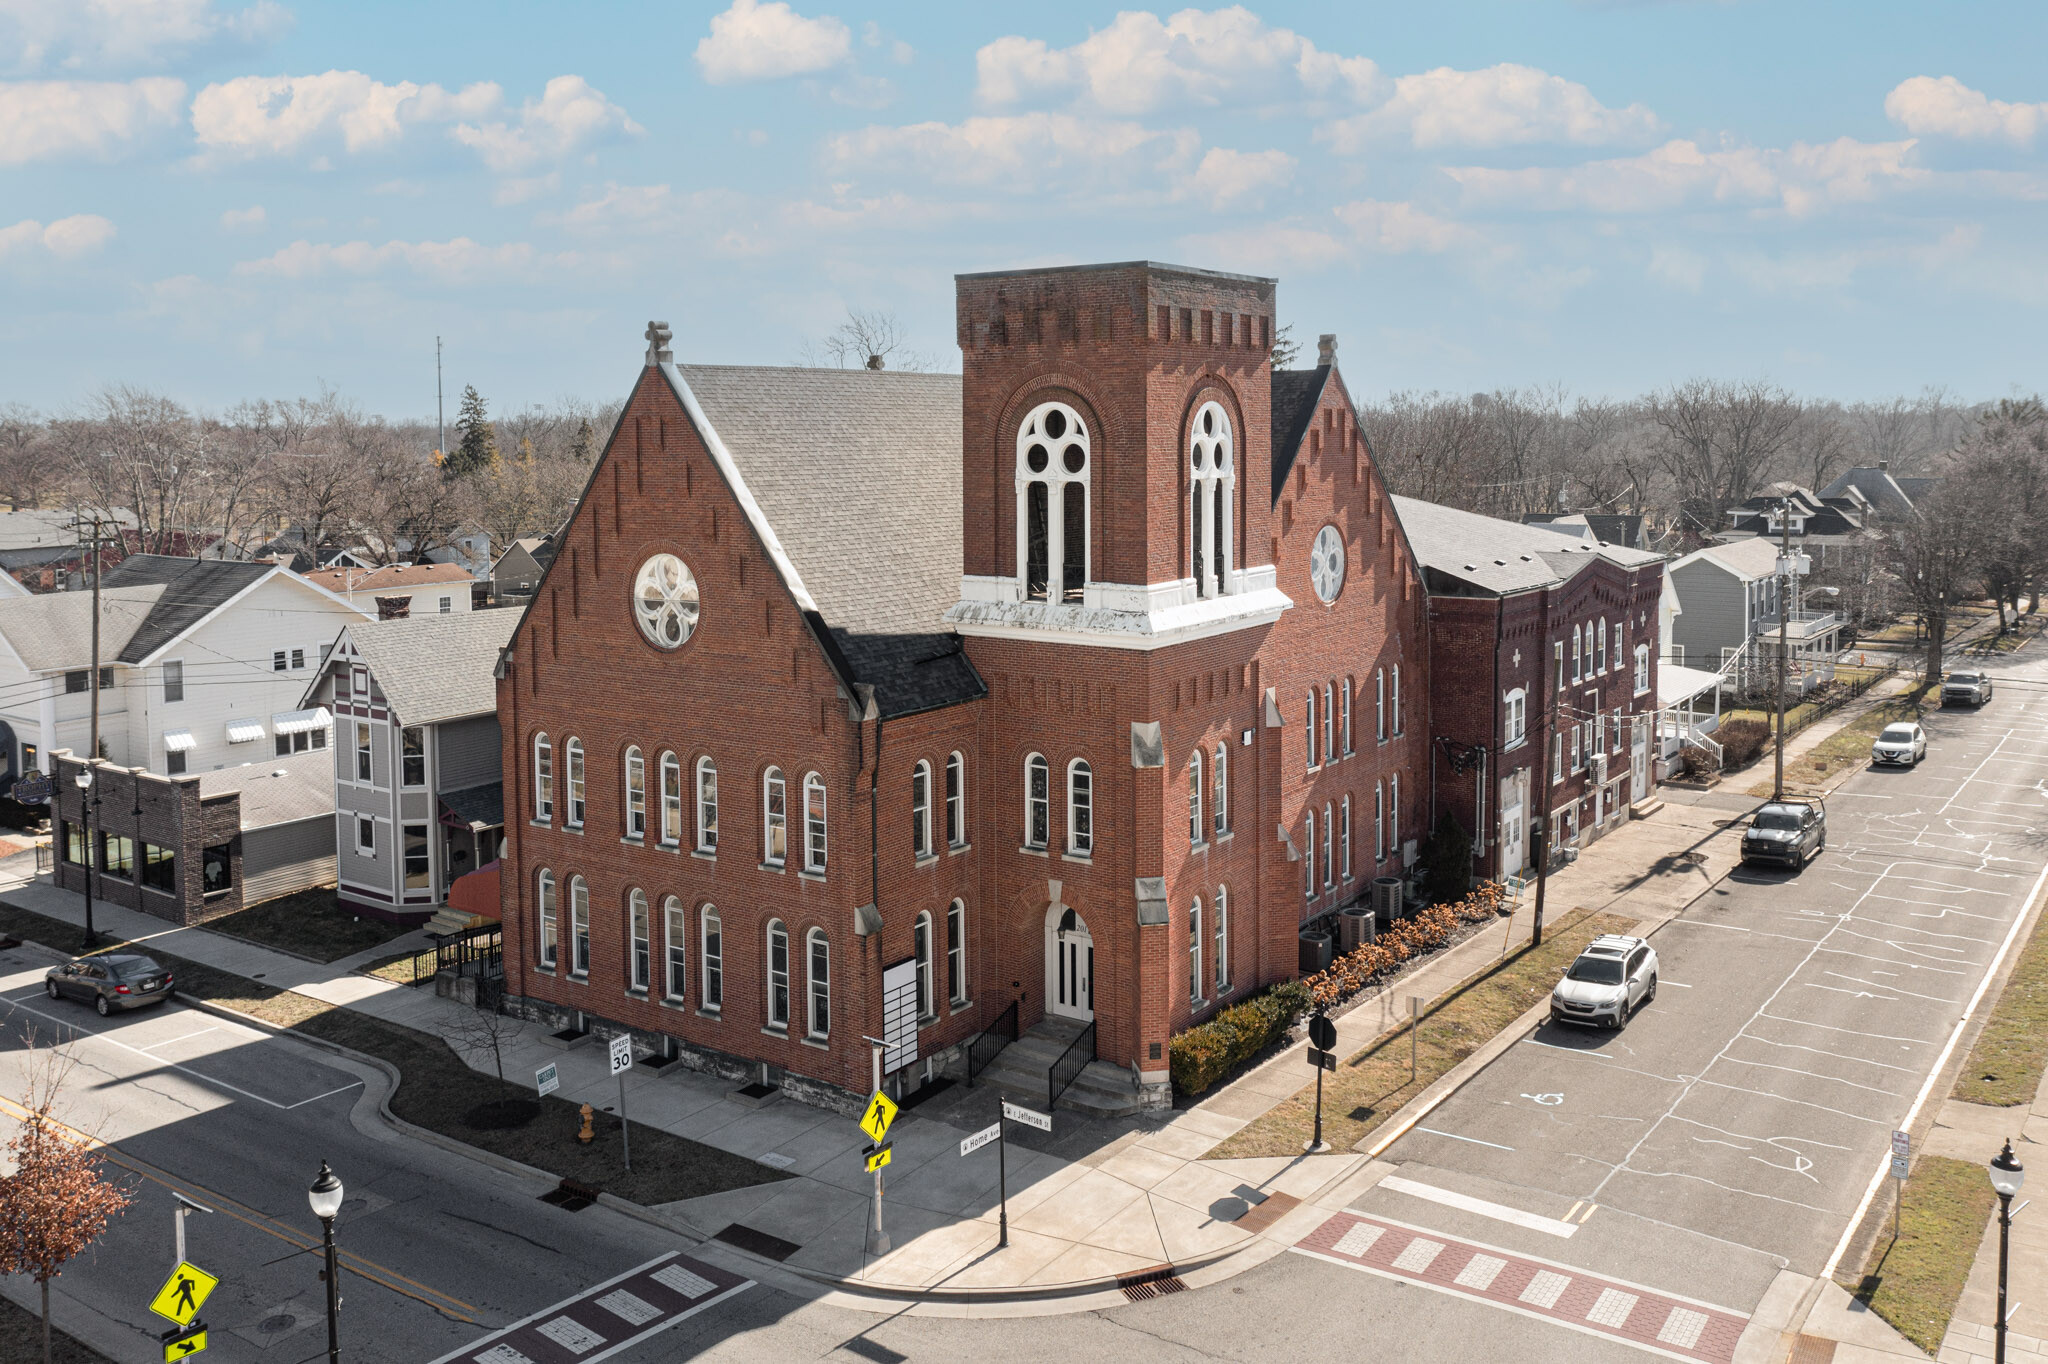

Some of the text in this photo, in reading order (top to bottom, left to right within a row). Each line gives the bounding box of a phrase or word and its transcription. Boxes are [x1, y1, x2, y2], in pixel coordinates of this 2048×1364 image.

[611, 1038, 629, 1050] SPEED
[613, 1045, 628, 1056] LIMIT
[613, 1053, 629, 1070] 30
[1017, 1110, 1043, 1126] Jefferson
[969, 1128, 999, 1148] Home Ave
